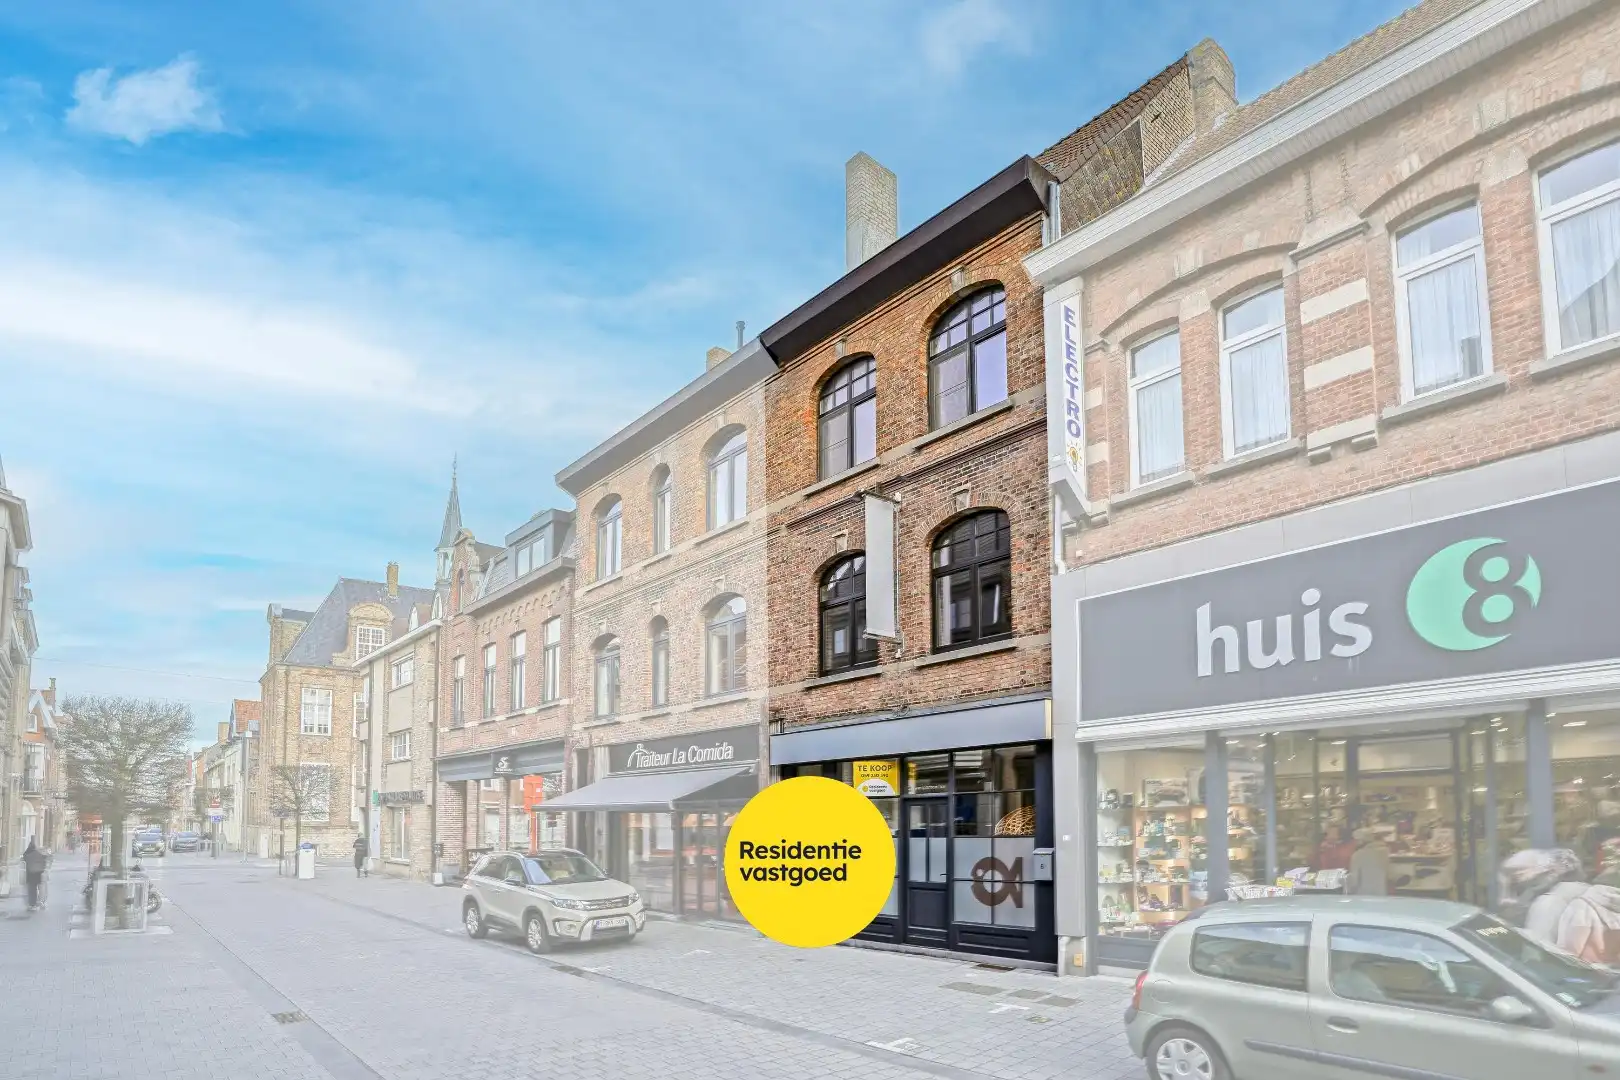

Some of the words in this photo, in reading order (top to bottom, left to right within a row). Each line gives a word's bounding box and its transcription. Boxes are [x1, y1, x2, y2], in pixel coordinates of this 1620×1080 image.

[1063, 304, 1081, 439] ELECTRO
[1196, 587, 1373, 677] huis
[636, 750, 672, 768] Traiteur
[672, 747, 685, 764] La
[688, 742, 734, 763] Comida
[870, 764, 893, 772] KOOP
